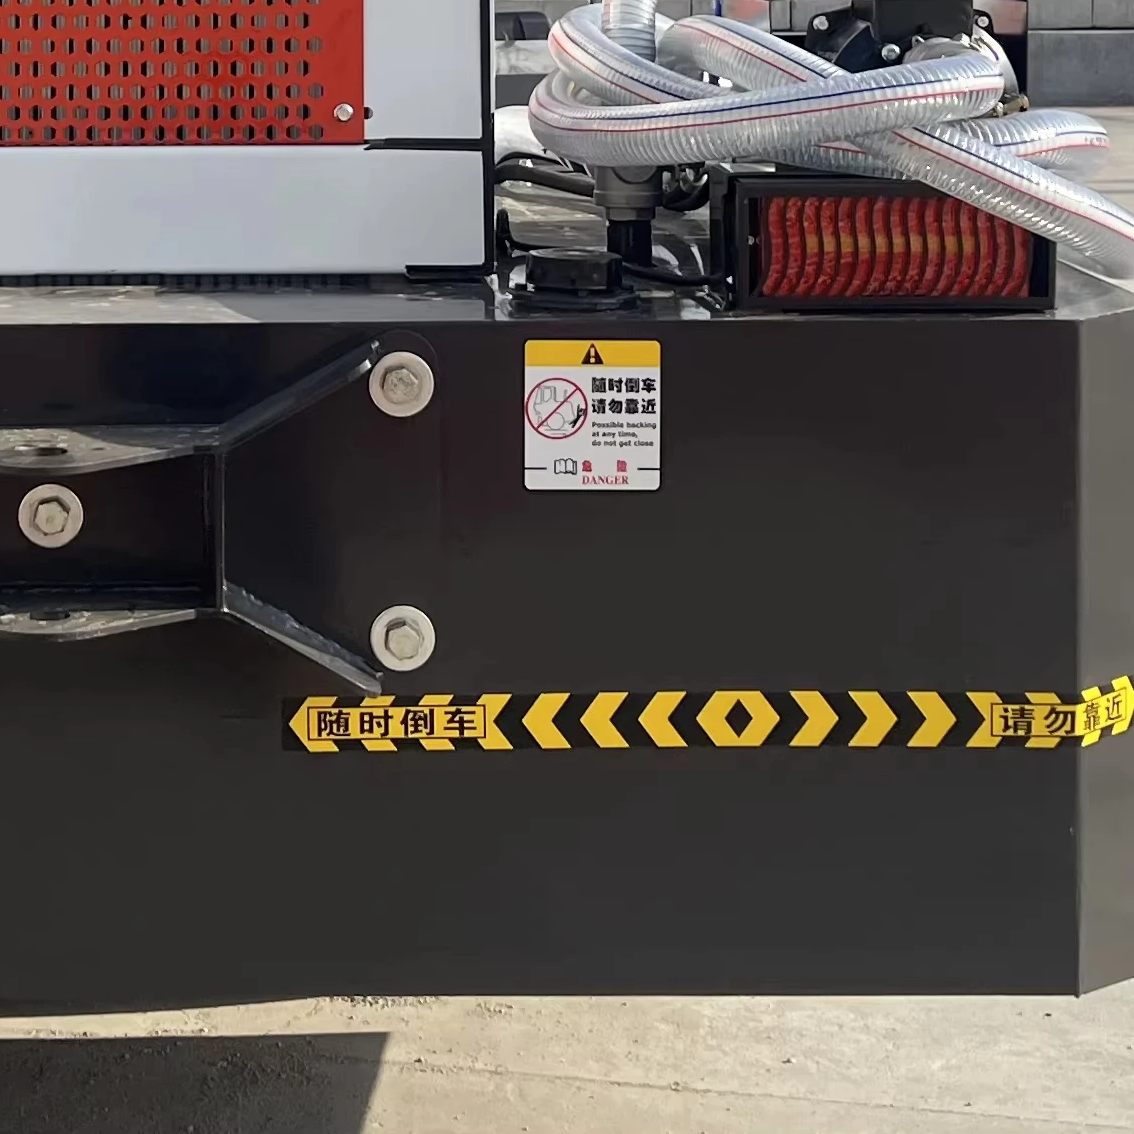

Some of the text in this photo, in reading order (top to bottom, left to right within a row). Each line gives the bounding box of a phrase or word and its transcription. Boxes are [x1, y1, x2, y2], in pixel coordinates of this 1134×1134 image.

[591, 377, 656, 393] 随时倒车
[591, 398, 656, 414] 请勿靠近
[626, 422, 657, 430] backing
[618, 440, 632, 448] get
[582, 475, 629, 485] DANGER
[999, 693, 1123, 735] 请勿靠近
[317, 707, 477, 738] 随时倒车
